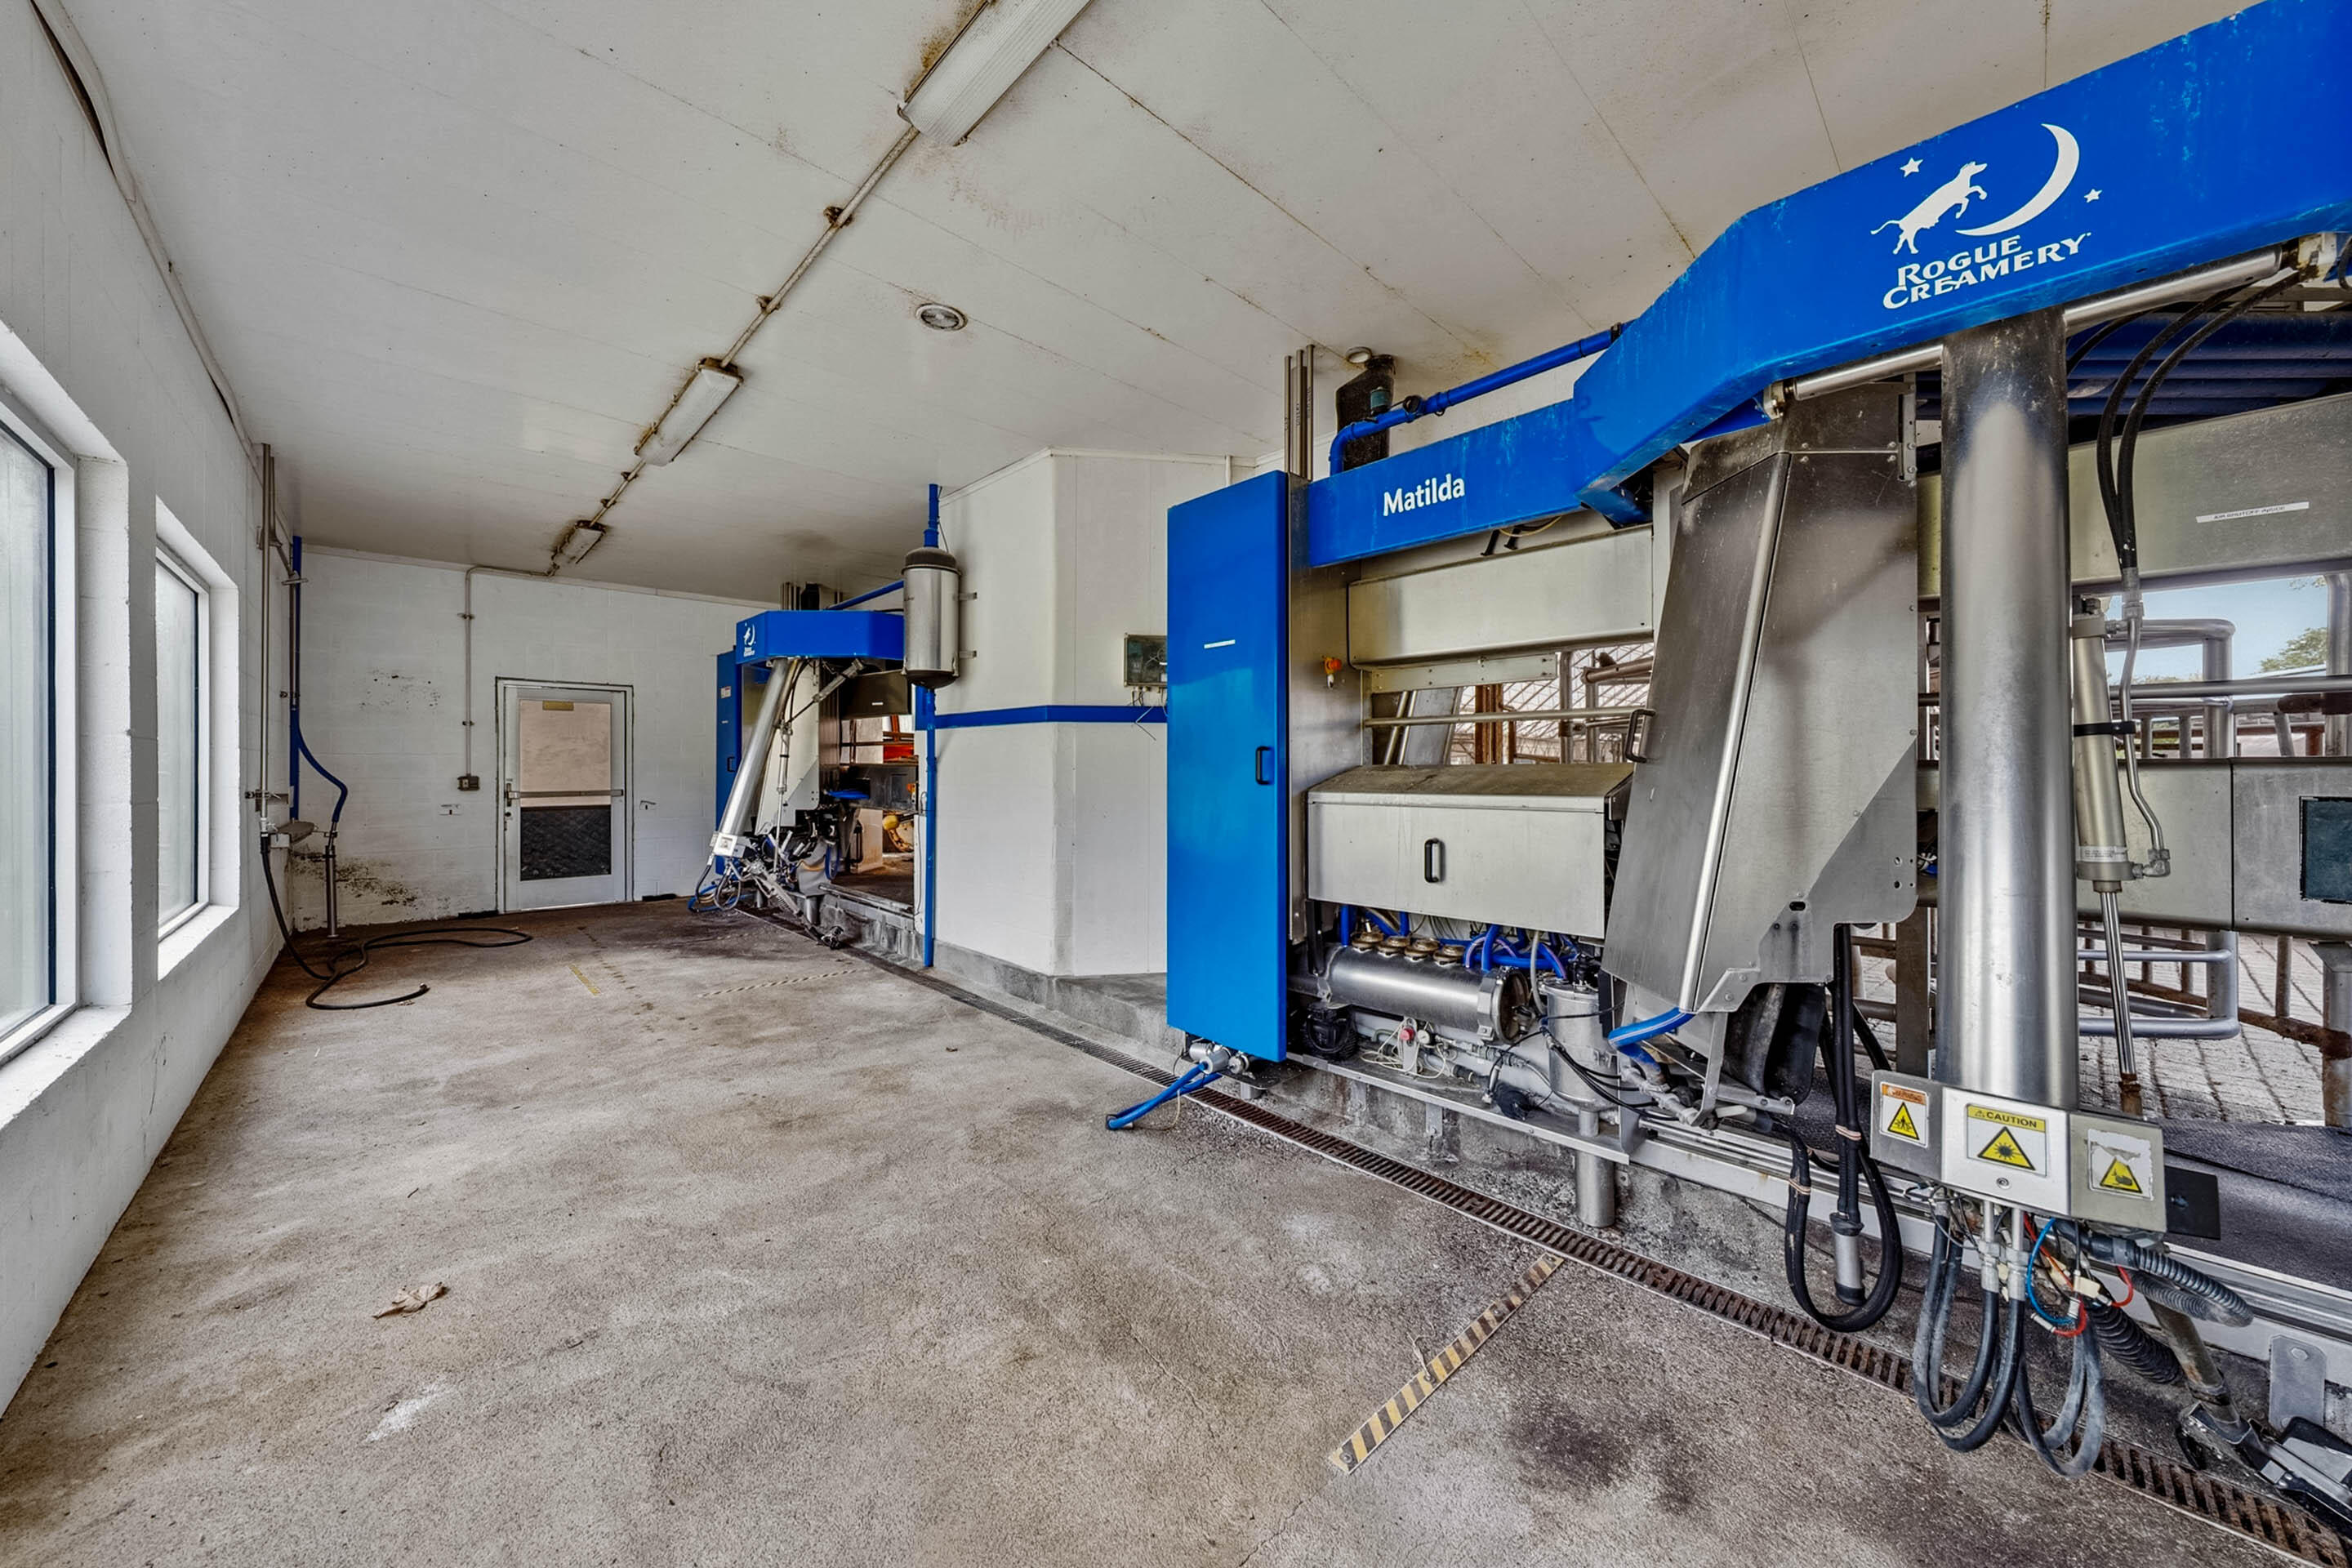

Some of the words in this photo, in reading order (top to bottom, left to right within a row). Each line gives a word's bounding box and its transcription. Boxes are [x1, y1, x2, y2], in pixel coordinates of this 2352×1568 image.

[1882, 232, 2091, 310] CREAMERY
[1897, 234, 2022, 287] ROGUE
[1383, 473, 1465, 517] Matilda
[1986, 1111, 2038, 1129] CAUTION
